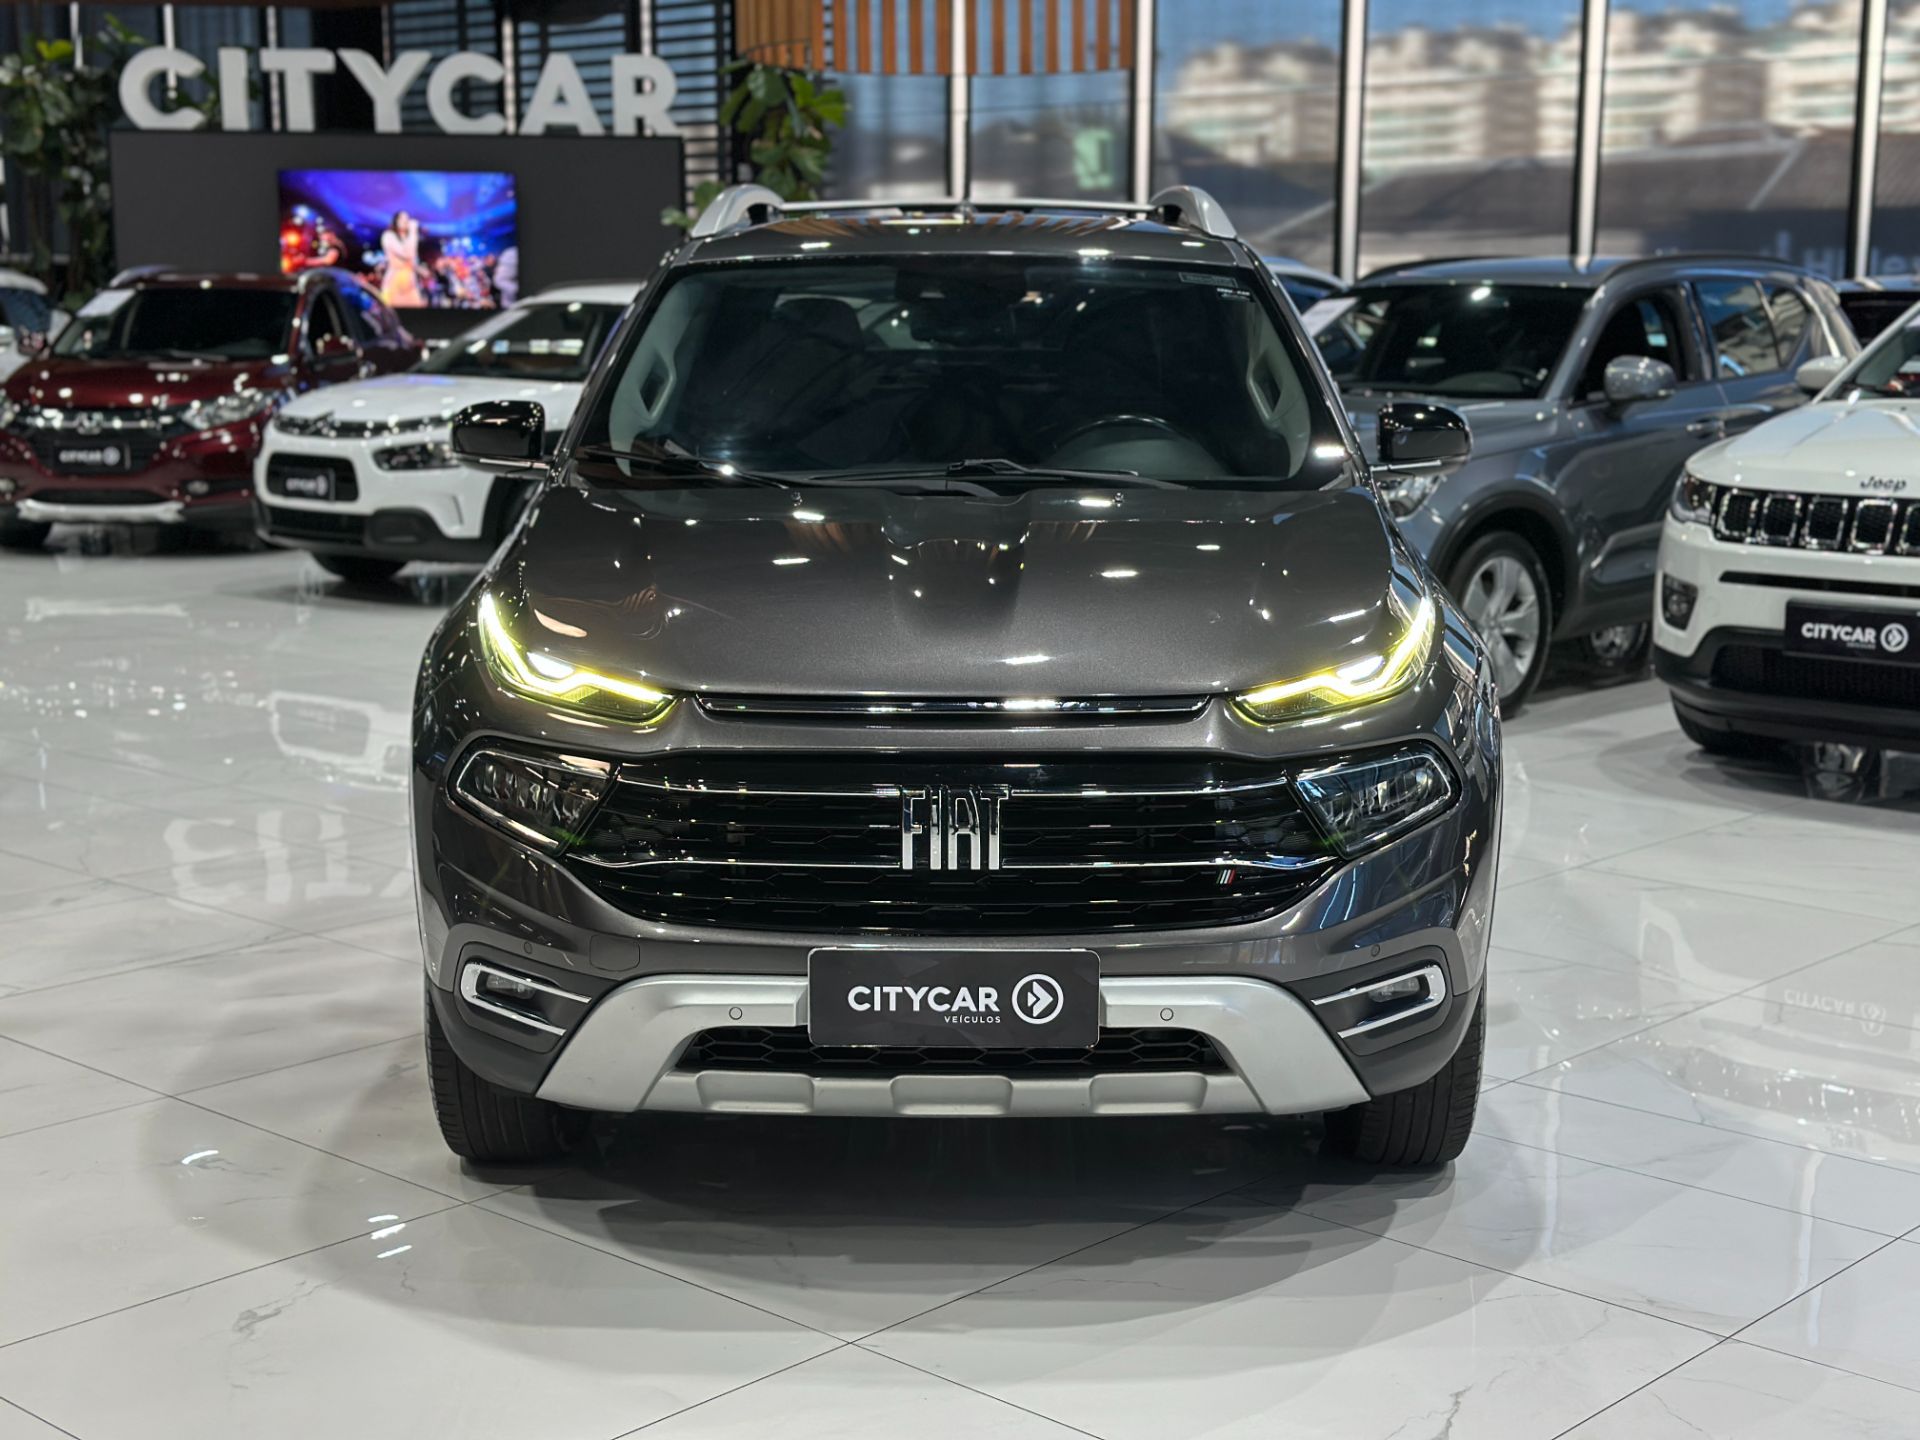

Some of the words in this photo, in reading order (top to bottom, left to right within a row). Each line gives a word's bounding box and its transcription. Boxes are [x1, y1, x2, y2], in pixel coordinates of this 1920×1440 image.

[119, 46, 681, 137] CITYCAR
[1860, 476, 1907, 493] Jeep
[1801, 622, 1877, 643] CITYCAR
[902, 786, 1009, 870] FIAT
[847, 985, 1001, 1012] CITYCAR
[944, 1014, 1001, 1024] VEÍCULOS
